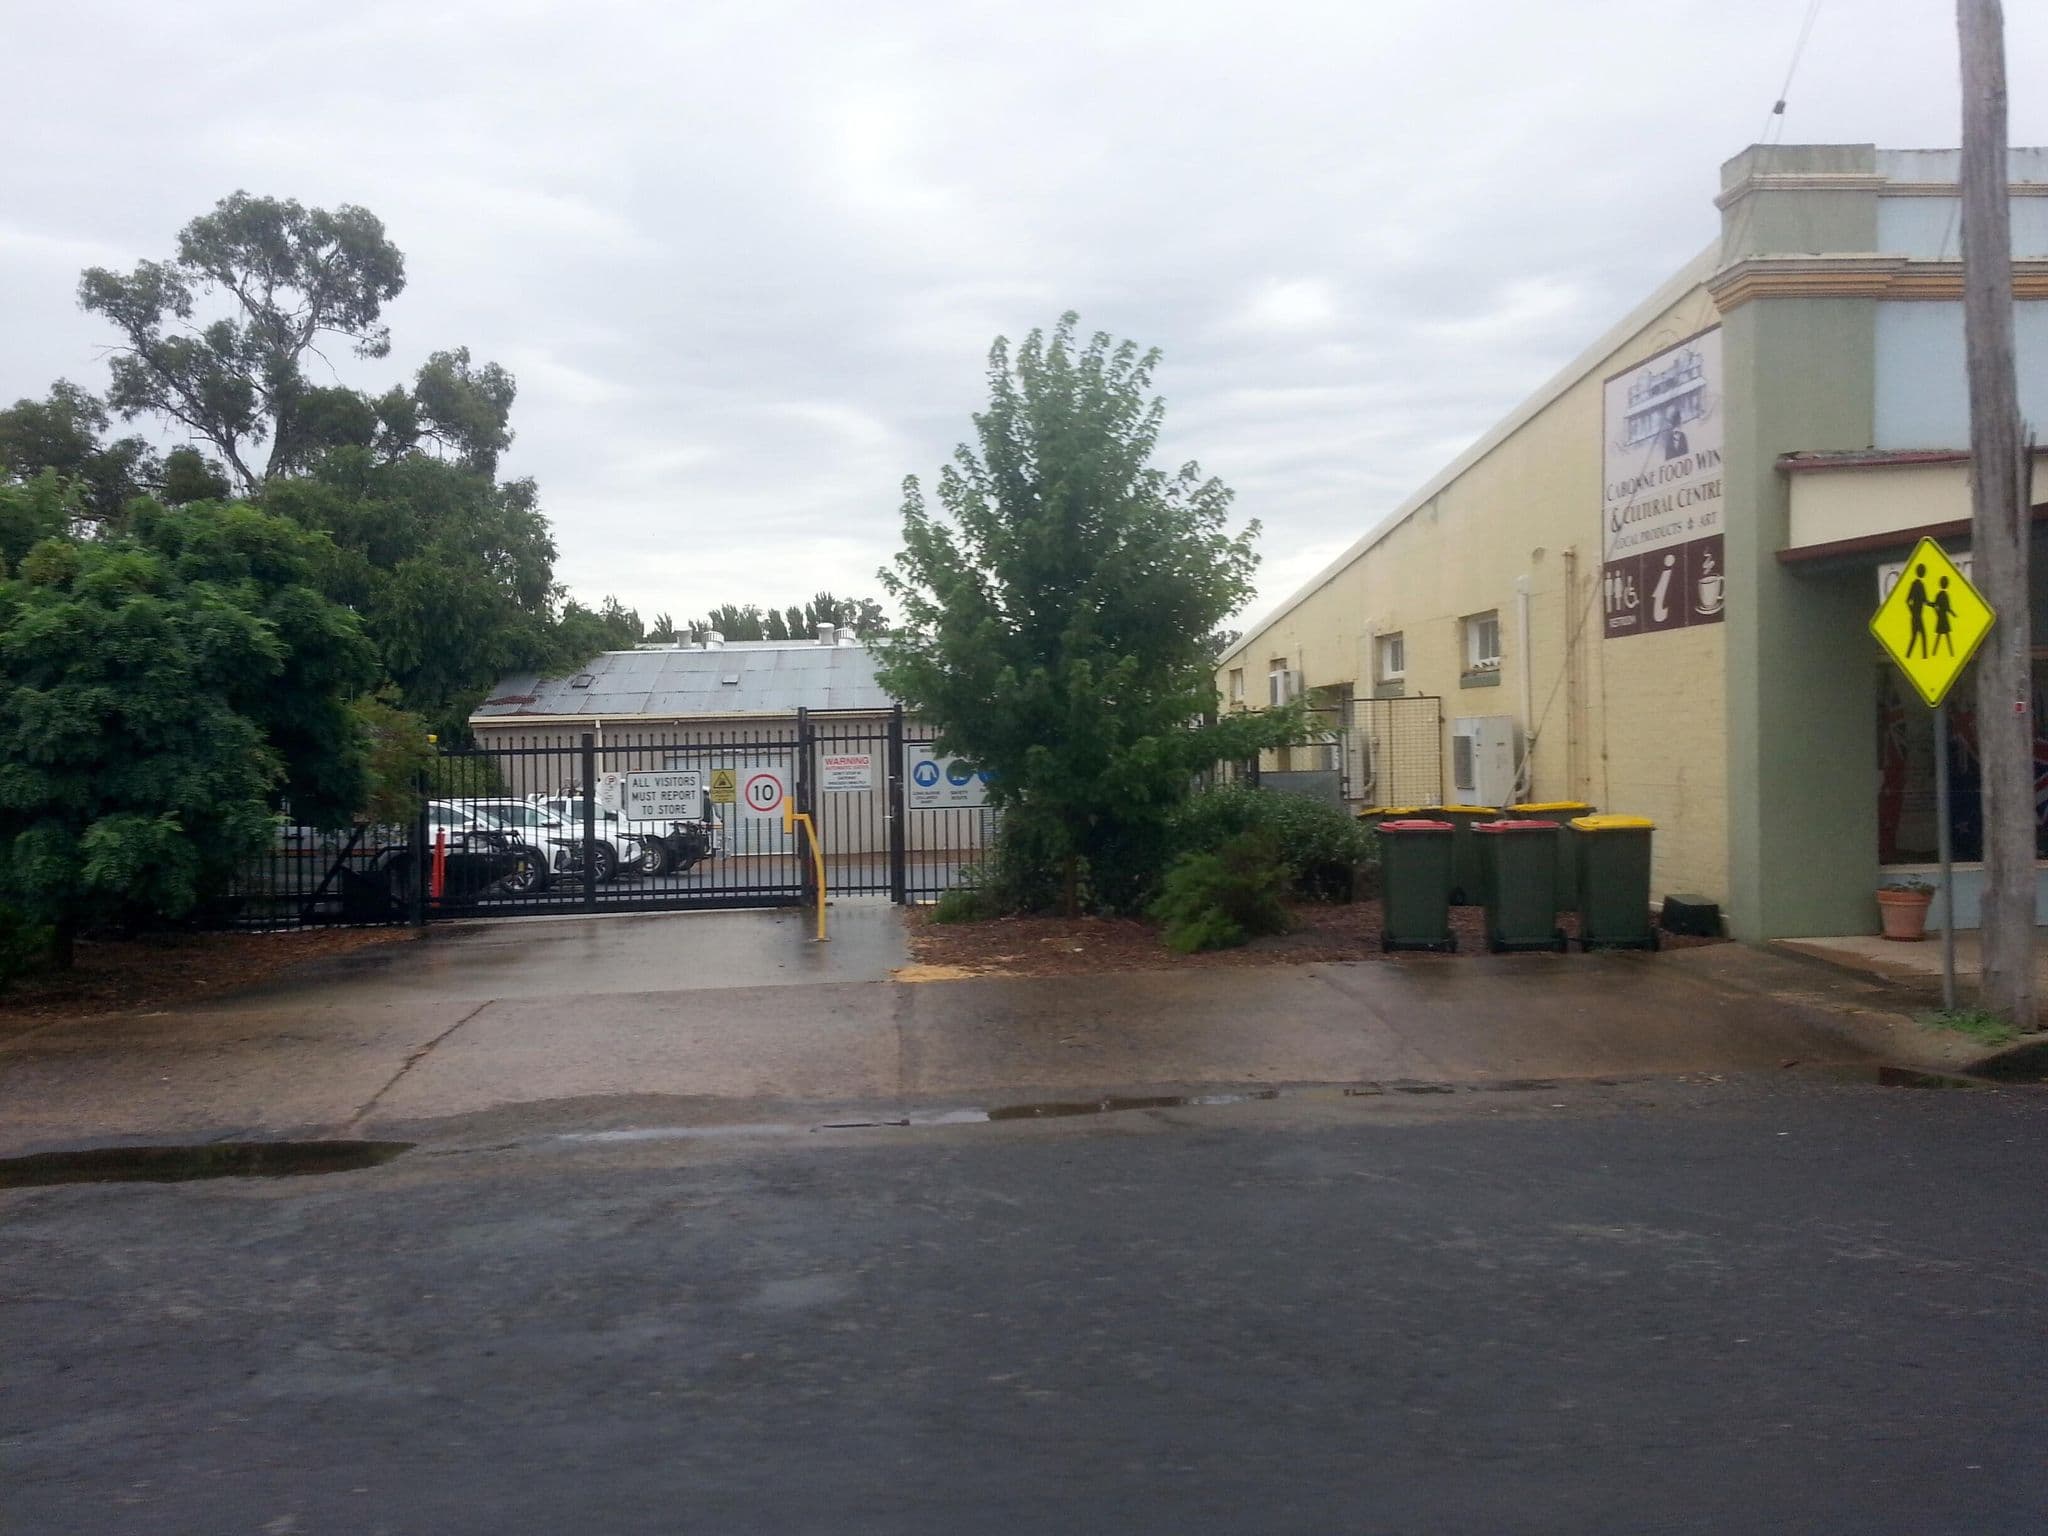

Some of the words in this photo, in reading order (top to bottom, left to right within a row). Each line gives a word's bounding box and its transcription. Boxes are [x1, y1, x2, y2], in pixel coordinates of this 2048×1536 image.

[1606, 471, 1655, 502] CABONNE
[1659, 458, 1694, 484] FOOD
[1696, 449, 1722, 469] WIN
[1611, 507, 1622, 533] &
[1623, 495, 1673, 525] CULTURAL
[1677, 479, 1722, 509] CENTRE
[1641, 522, 1683, 543] PRODUCTS
[825, 756, 869, 766] WARNING
[632, 777, 650, 788] ALL
[655, 776, 696, 787] VISITORS
[632, 791, 656, 802] MUST
[661, 790, 696, 801] REPORT
[754, 784, 774, 801] 10
[642, 805, 653, 815] TO
[658, 804, 687, 815] STORE
